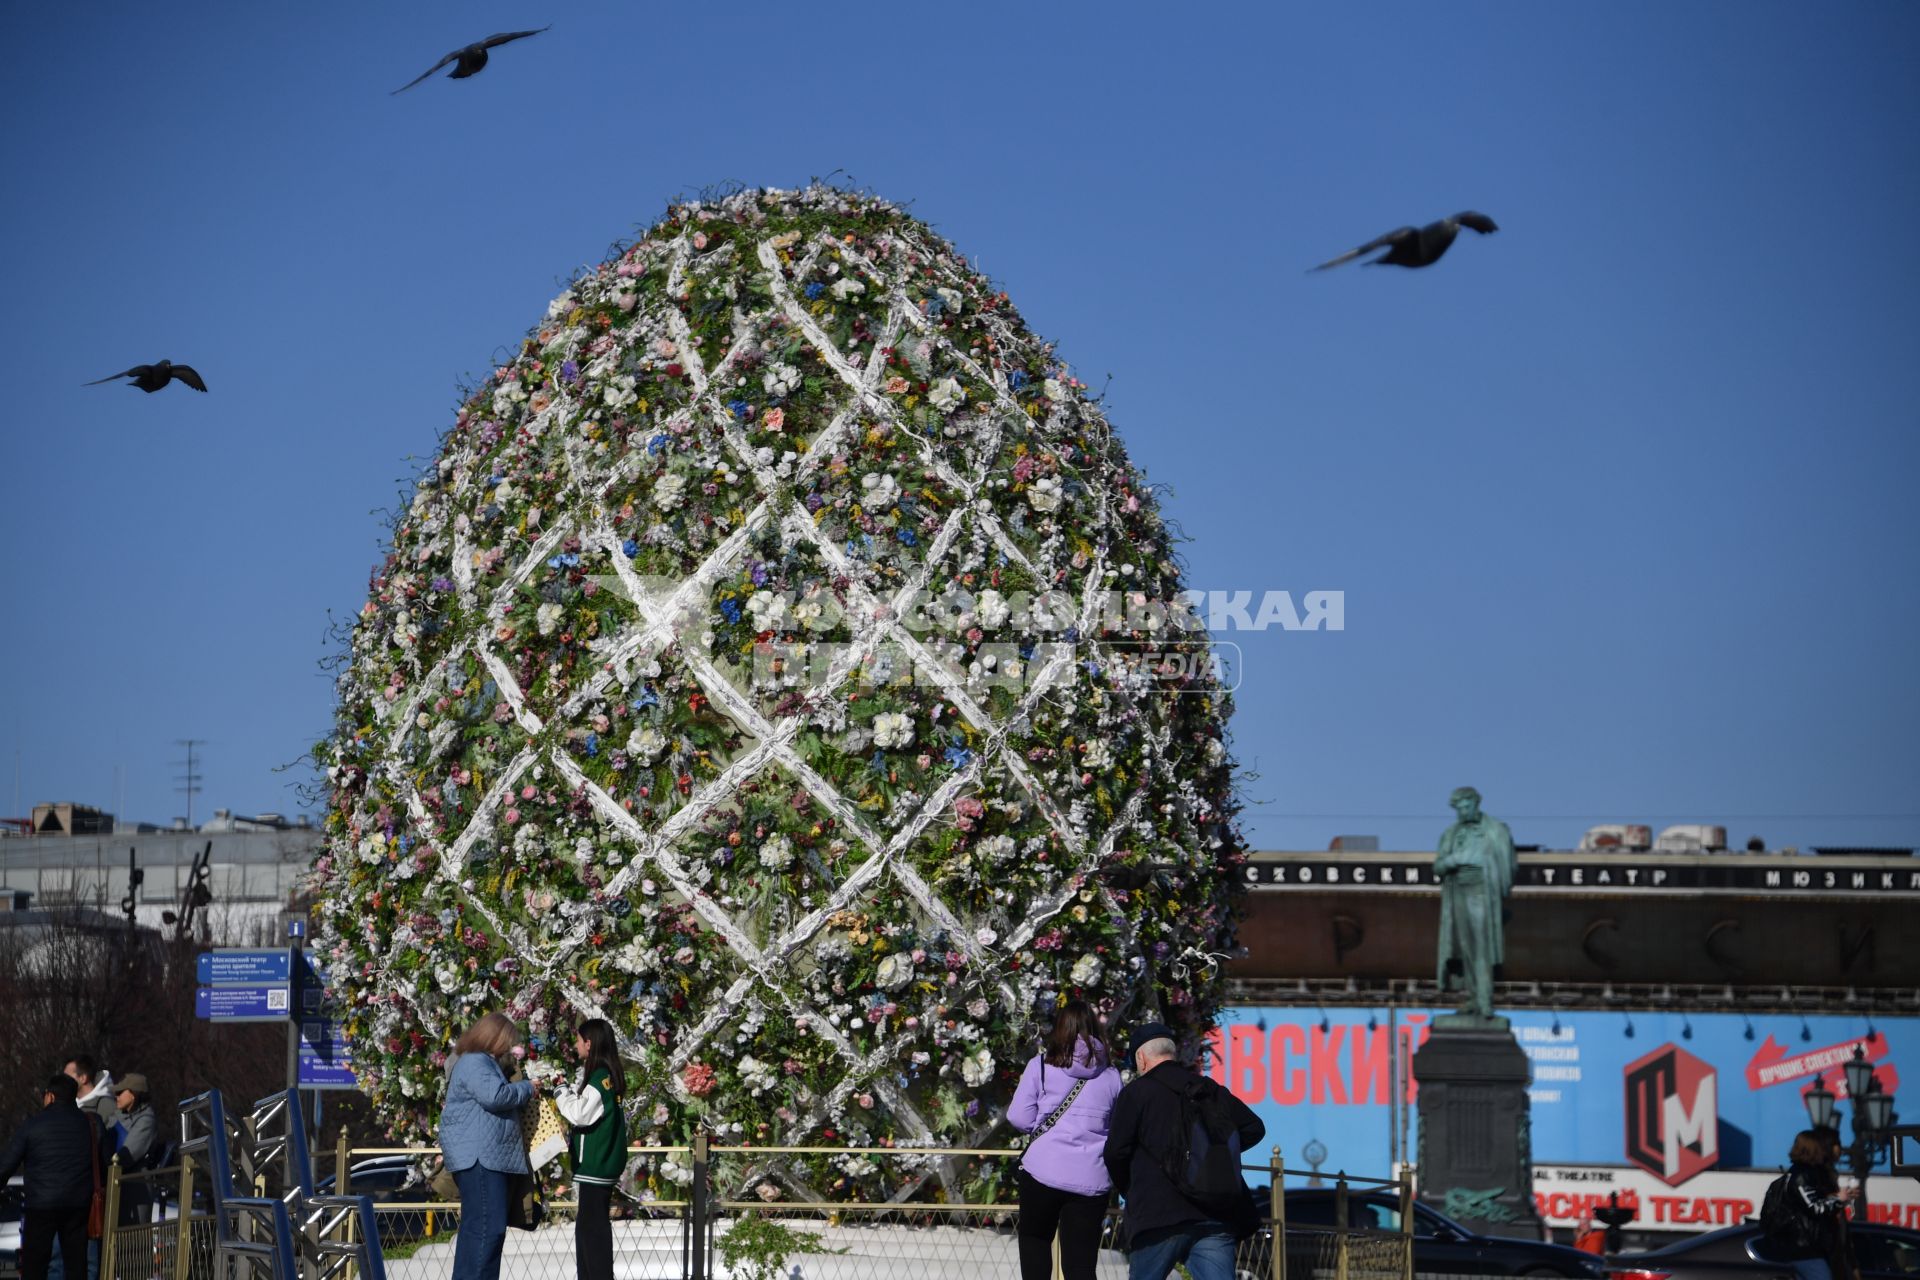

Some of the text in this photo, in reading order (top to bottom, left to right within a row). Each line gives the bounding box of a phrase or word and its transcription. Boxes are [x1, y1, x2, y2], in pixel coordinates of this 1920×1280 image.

[1542, 868, 1667, 886] ТЕАТР
[1557, 1171, 1616, 1182] THEATRE
[1649, 1195, 1754, 1225] ТЕАТР
